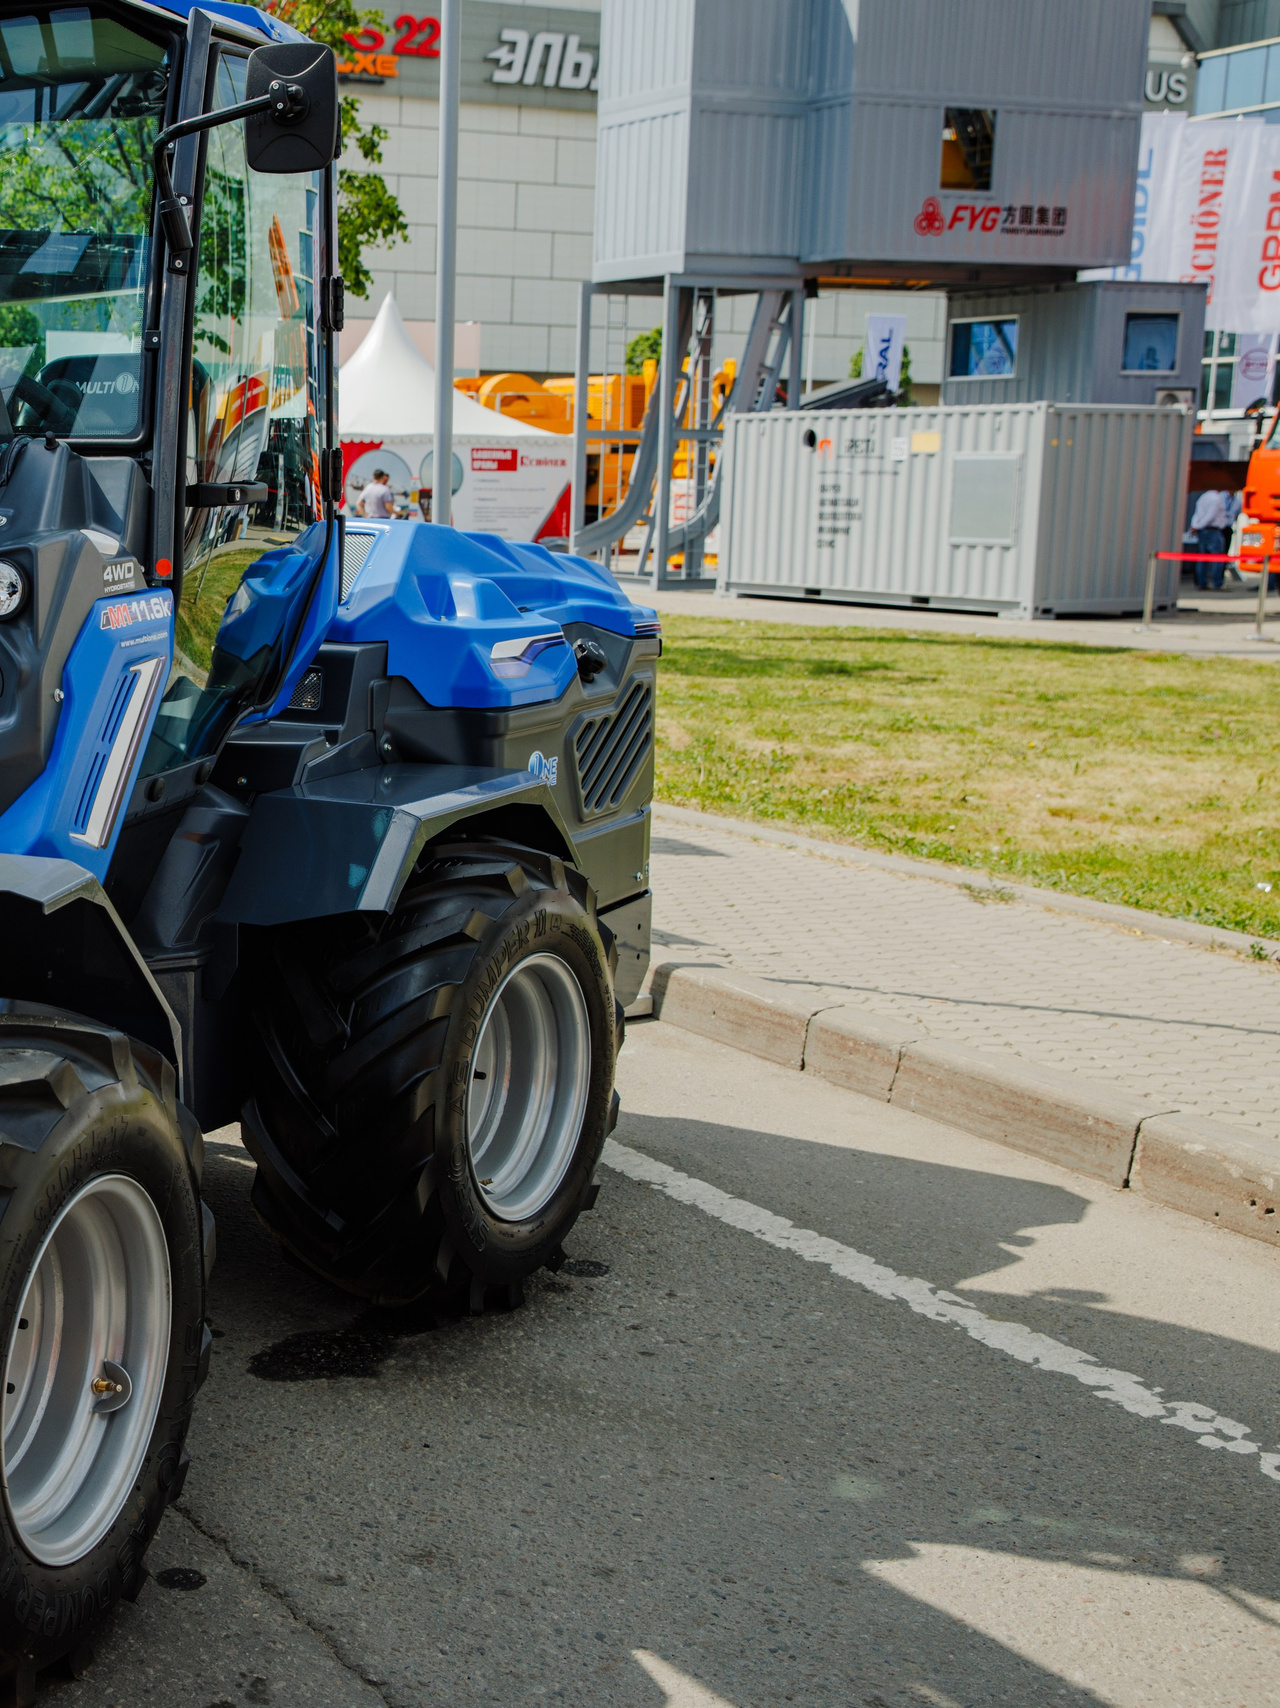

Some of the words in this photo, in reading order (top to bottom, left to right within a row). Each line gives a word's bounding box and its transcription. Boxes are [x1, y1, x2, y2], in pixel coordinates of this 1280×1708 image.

[393, 14, 441, 57] 22
[487, 27, 600, 90] ЭЛЬ
[947, 205, 1002, 232] FYG
[103, 562, 135, 582] 4WD
